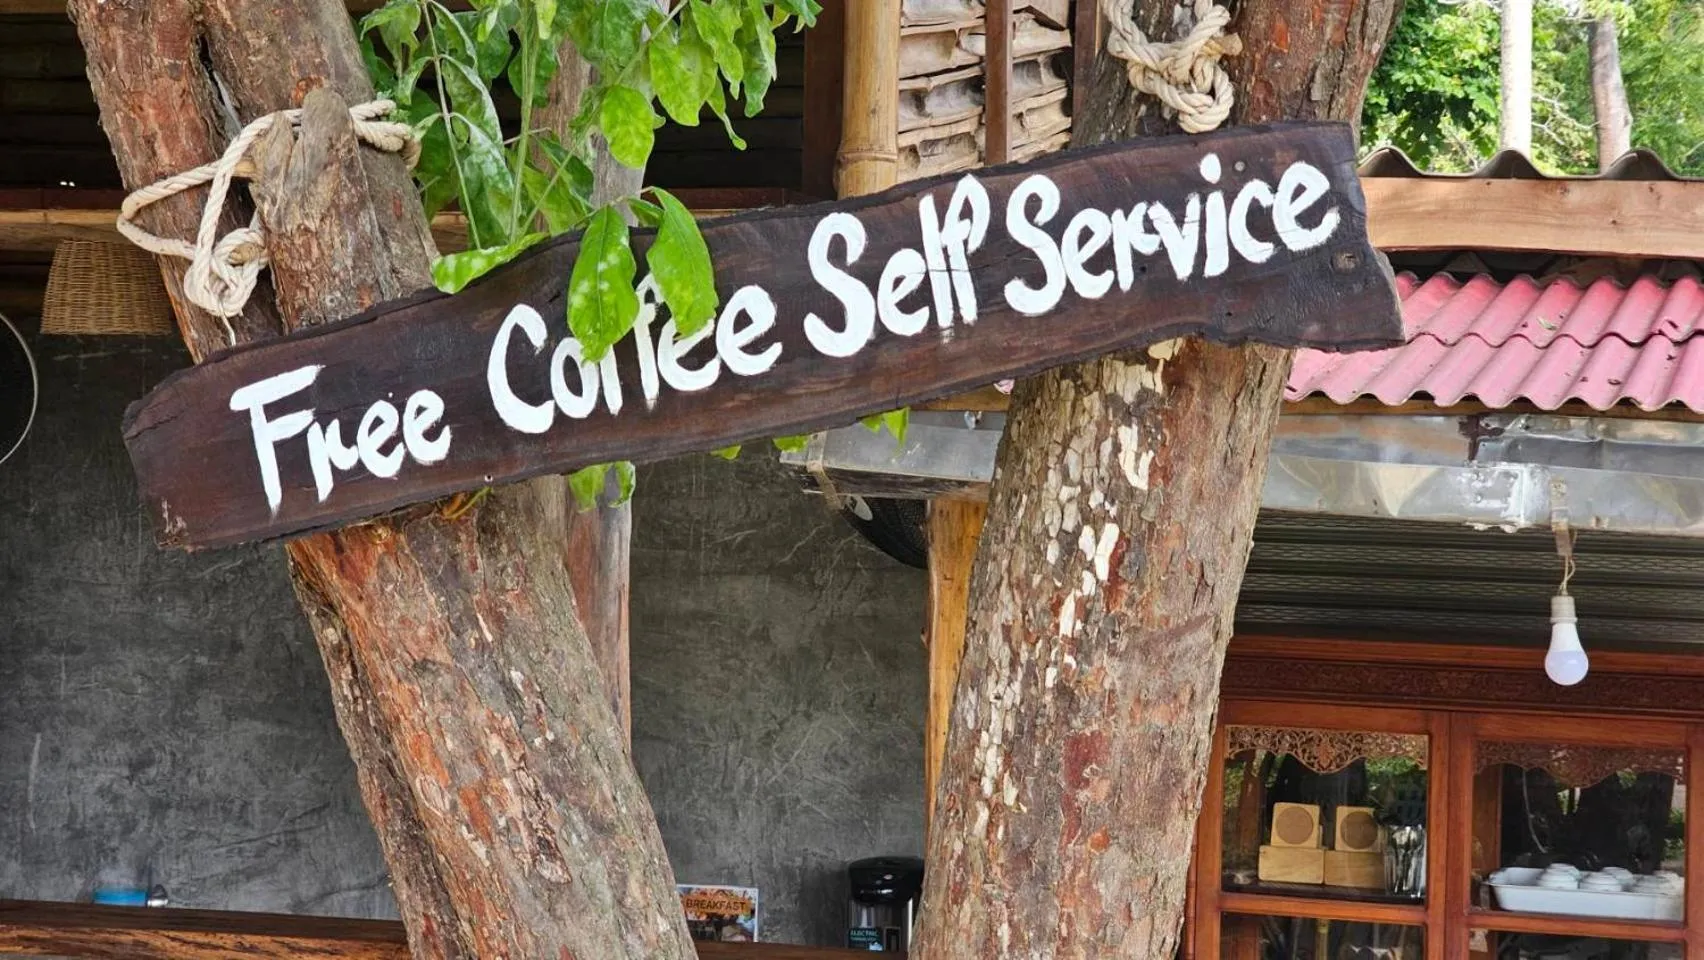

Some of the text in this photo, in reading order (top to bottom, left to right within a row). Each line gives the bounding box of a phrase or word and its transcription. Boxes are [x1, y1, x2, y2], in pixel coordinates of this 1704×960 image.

[229, 364, 453, 516] Free
[803, 174, 991, 358] Self
[1003, 153, 1341, 317] Service
[685, 898, 746, 912] BREAKFAST
